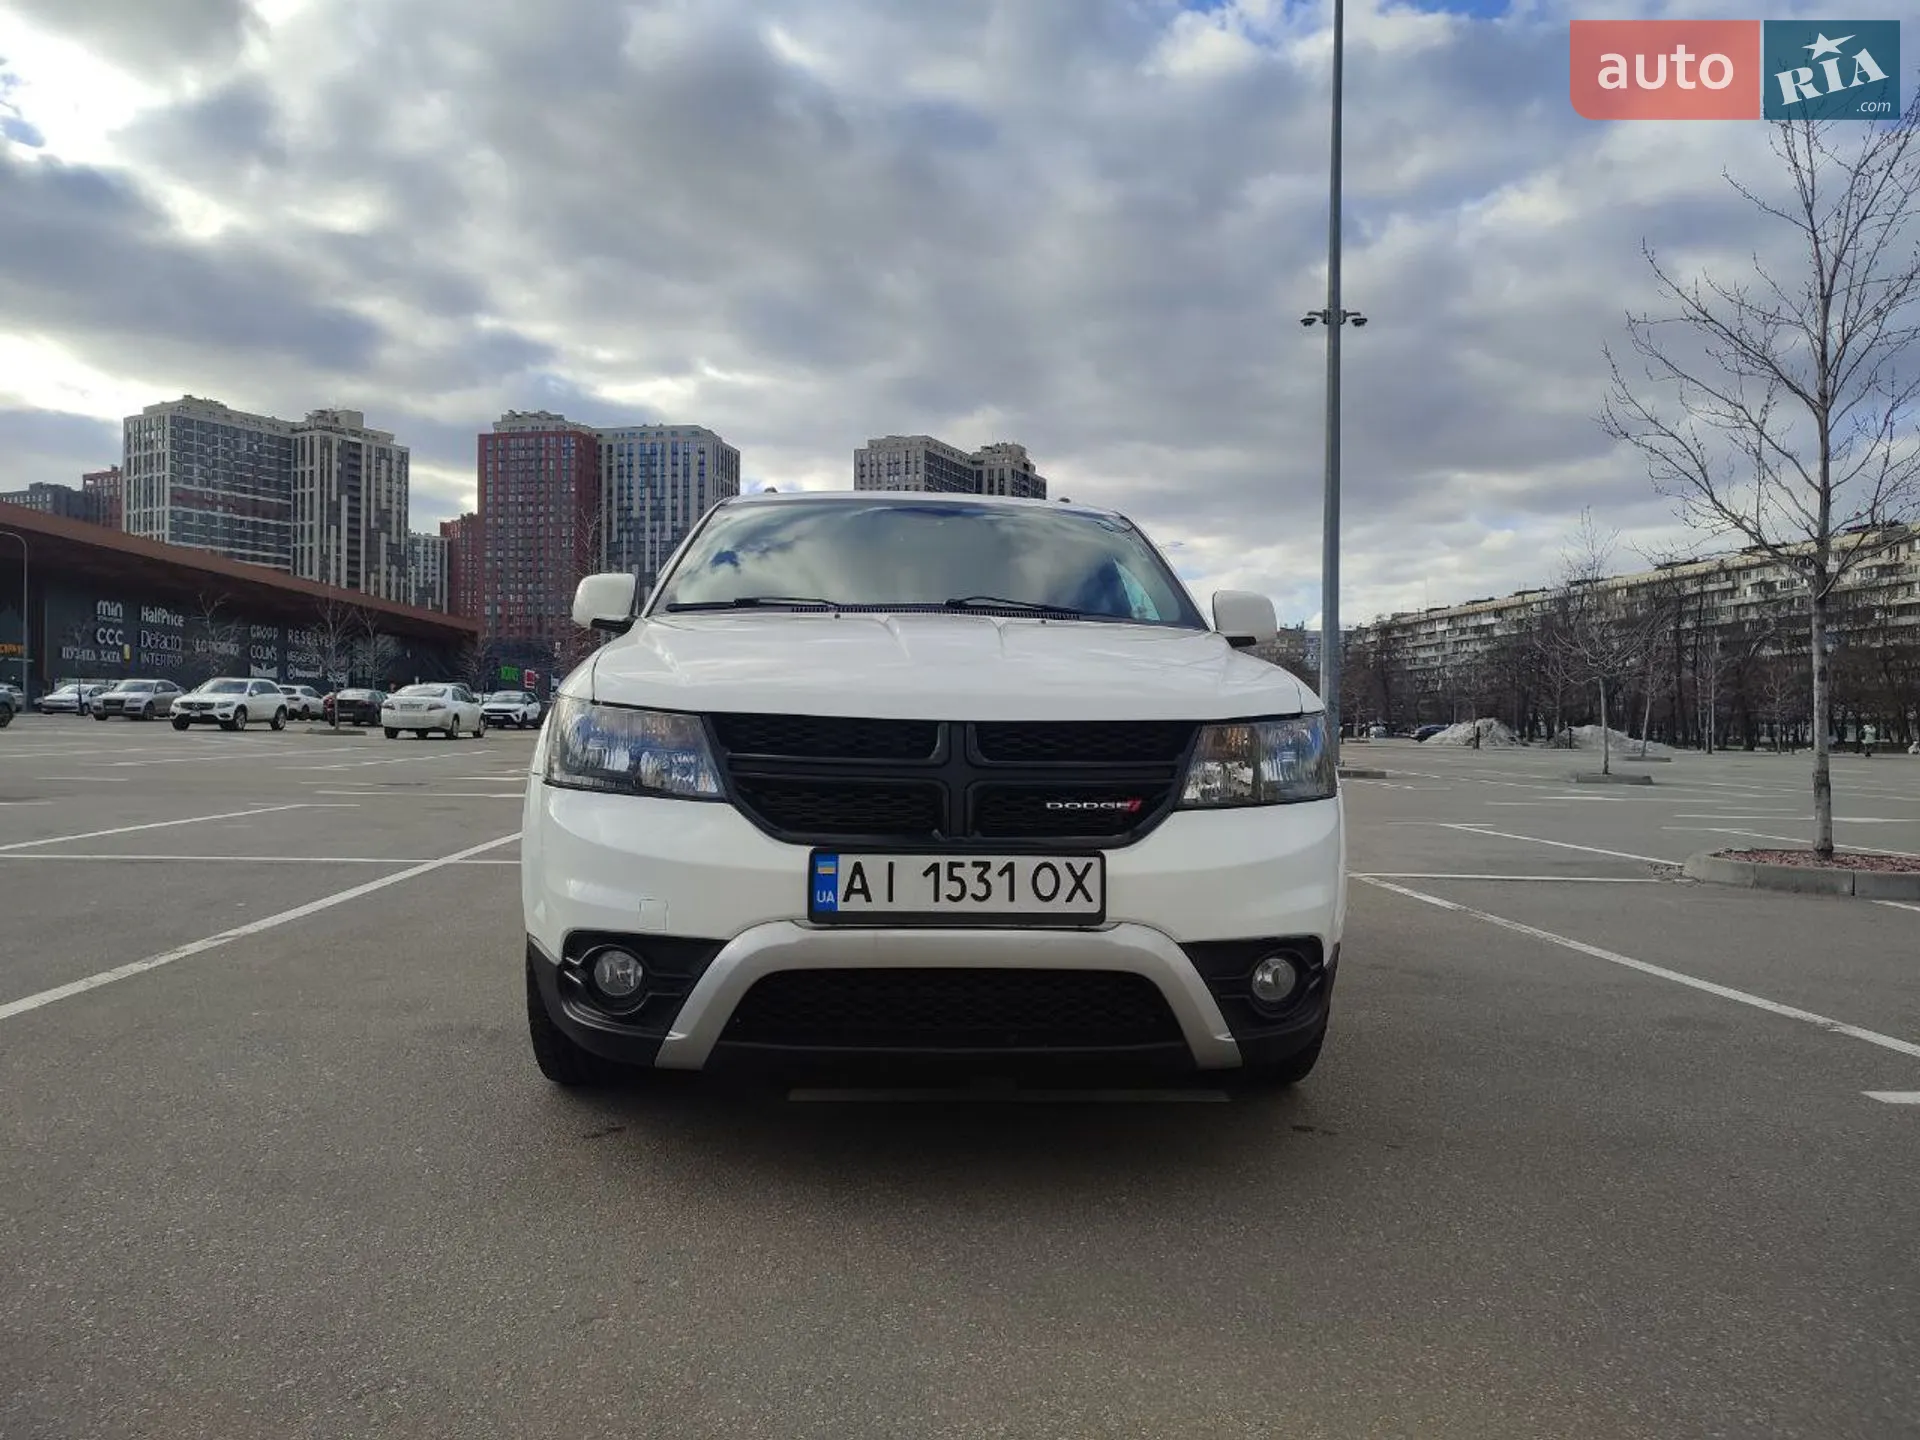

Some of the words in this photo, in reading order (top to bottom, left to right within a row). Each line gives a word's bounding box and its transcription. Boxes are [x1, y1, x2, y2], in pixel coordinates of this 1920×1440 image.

[141, 606, 184, 627] HalfPrice
[96, 627, 124, 646] CCC
[1046, 801, 1132, 810] DODGE
[842, 861, 894, 903] AI
[922, 861, 1015, 903] 1531
[1031, 861, 1094, 903] OX
[816, 890, 835, 903] UA
